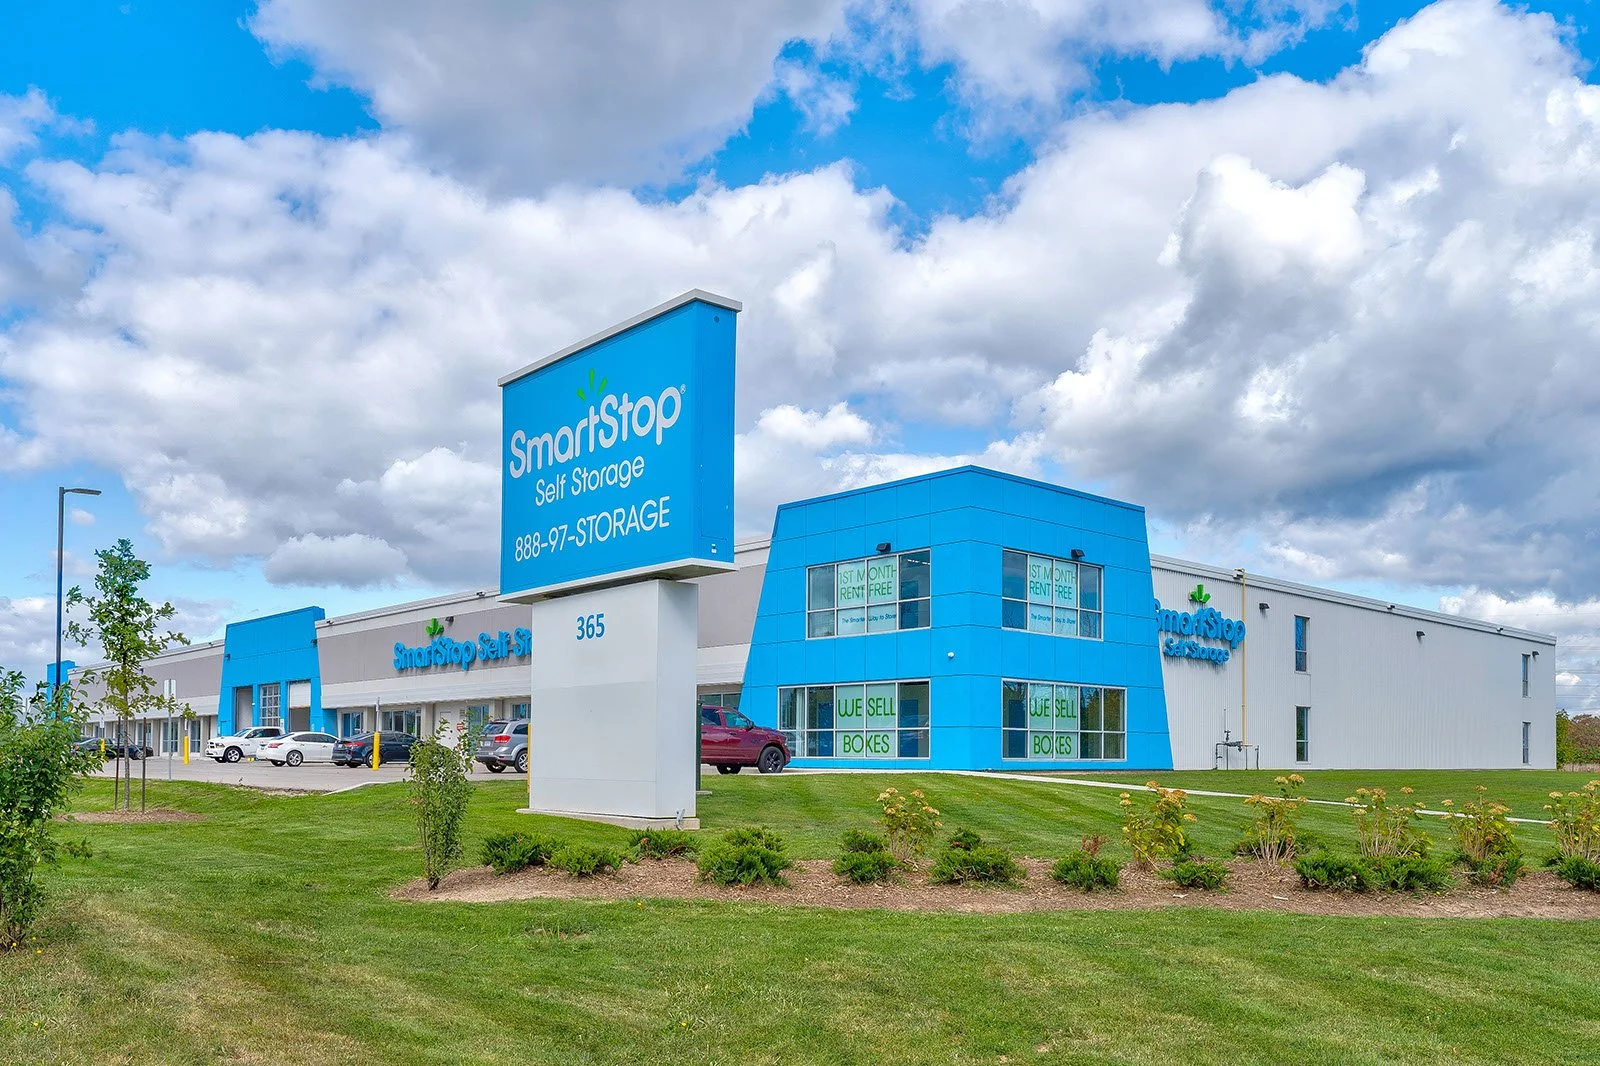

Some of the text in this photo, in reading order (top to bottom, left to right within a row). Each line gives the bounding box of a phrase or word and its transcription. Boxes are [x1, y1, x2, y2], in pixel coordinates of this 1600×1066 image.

[509, 386, 682, 479] SmartStop
[535, 455, 645, 506] Self Storage
[514, 495, 671, 562] 888-97-STORAGE
[840, 581, 892, 600] RENT FREE
[1029, 580, 1051, 596] RENT
[576, 613, 605, 640] 365
[393, 635, 476, 671] SmartStop
[477, 630, 510, 661] Self
[1164, 637, 1230, 665] Self Storage
[838, 697, 896, 717] WE SELL
[1029, 697, 1077, 718] WE SELL
